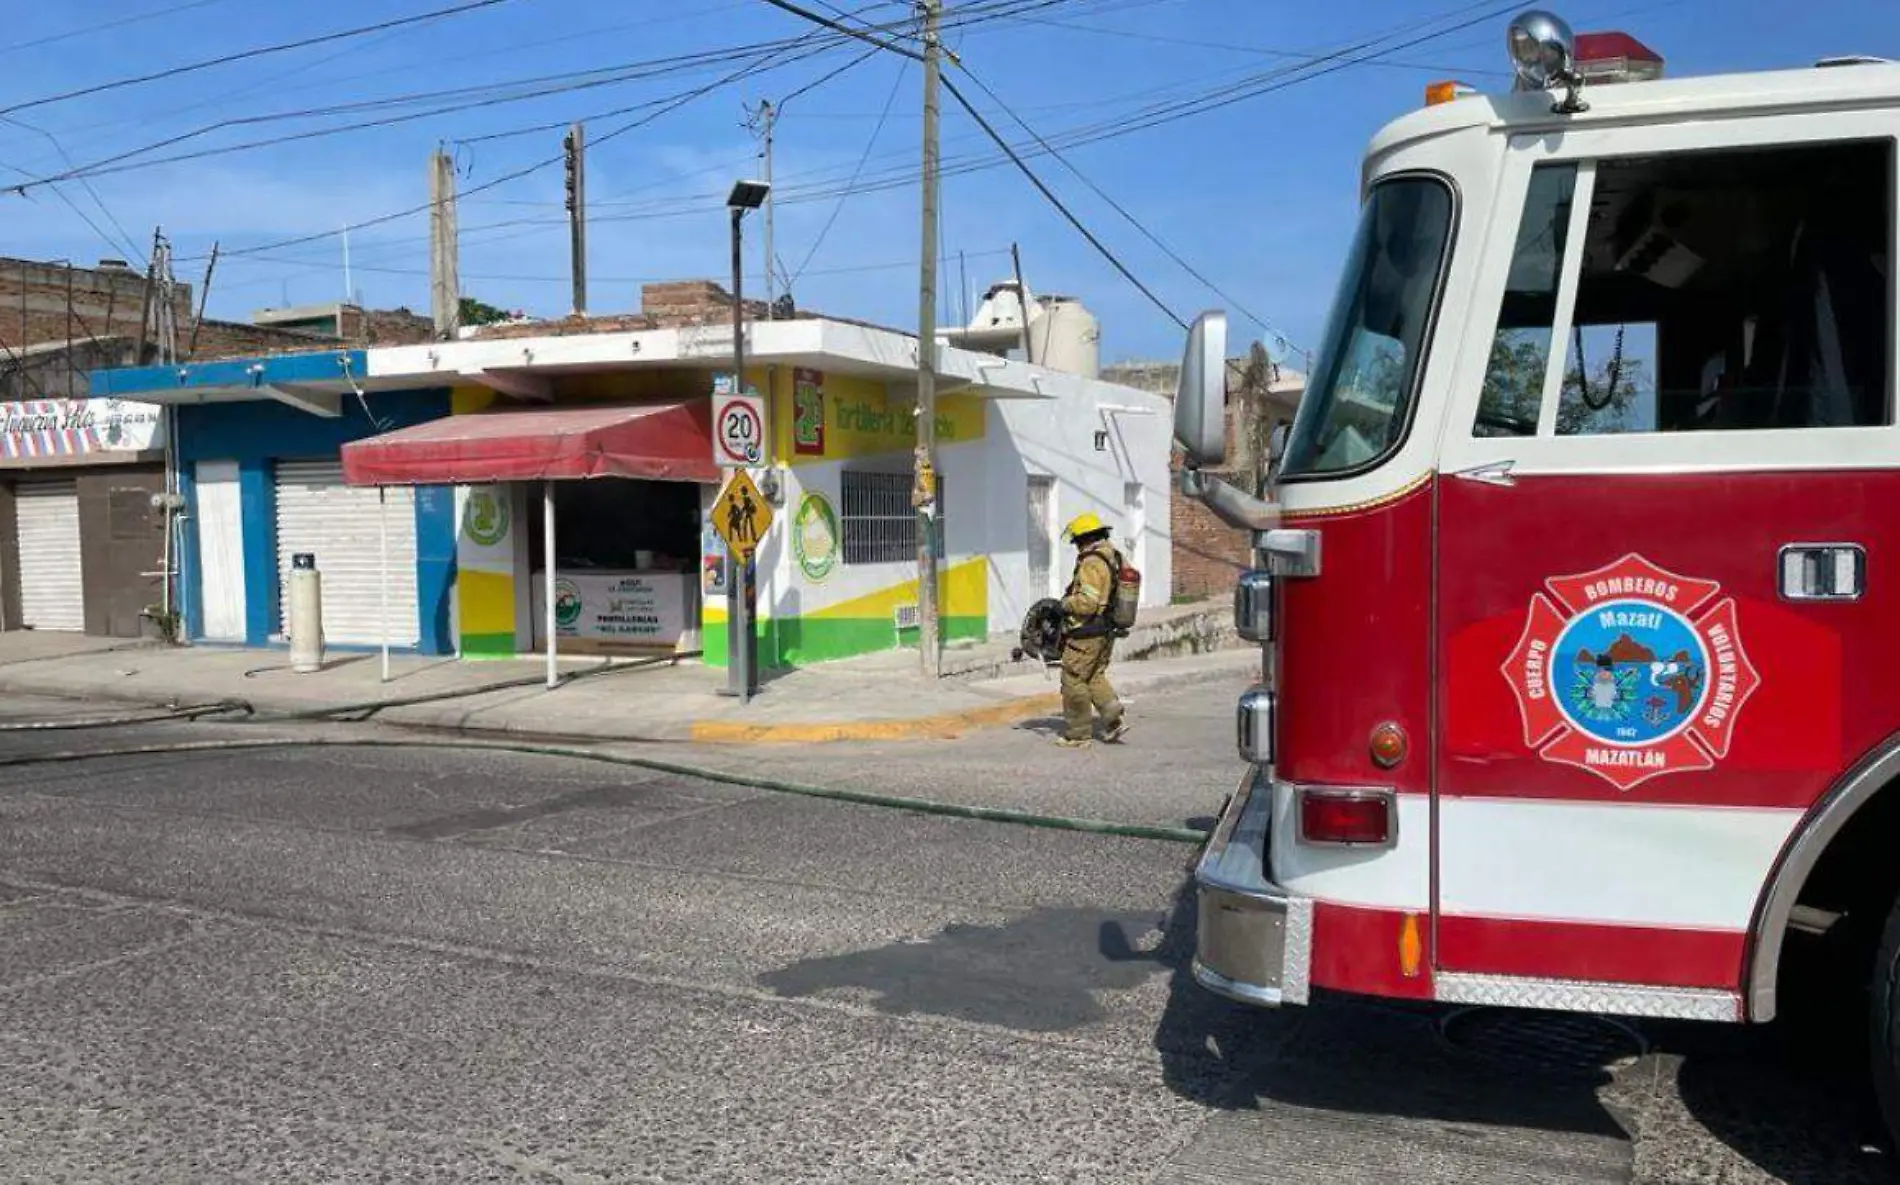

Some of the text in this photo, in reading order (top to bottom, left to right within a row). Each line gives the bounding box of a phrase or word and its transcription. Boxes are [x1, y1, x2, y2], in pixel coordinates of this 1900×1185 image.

[728, 413, 752, 438] 20
[1584, 576, 1679, 601] BOMBEROS
[1526, 639, 1548, 699] CUERPO
[1705, 623, 1737, 729] VOLUNTARIOS
